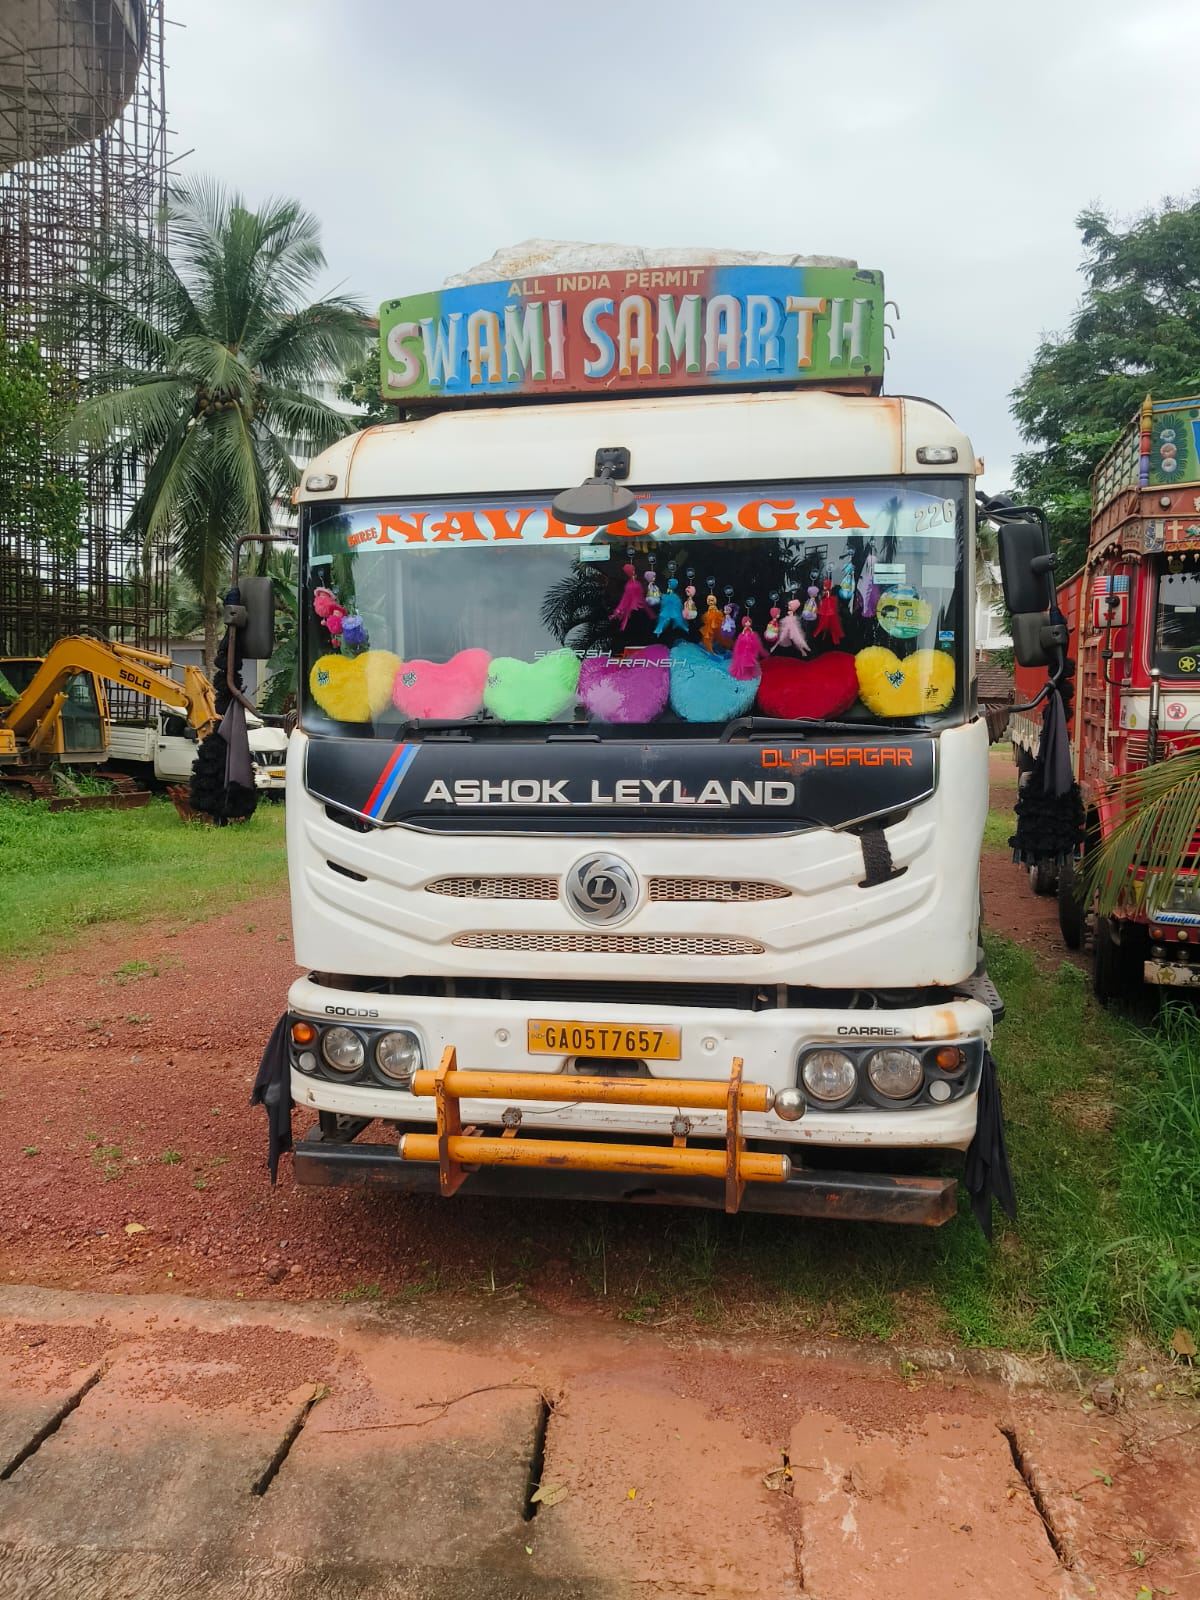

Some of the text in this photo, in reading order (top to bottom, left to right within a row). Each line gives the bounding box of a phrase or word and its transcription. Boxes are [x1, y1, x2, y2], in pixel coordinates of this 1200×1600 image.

[507, 269, 705, 297] ALL INDIA PERMIT
[387, 294, 868, 388] SWAMI SAMARTH
[914, 498, 956, 532] 226
[605, 658, 687, 669] PRANSH
[119, 669, 152, 690] SDLG
[423, 779, 796, 807] ASHOK LEYLAND
[590, 877, 615, 899] L
[325, 1005, 379, 1018] GOODS
[545, 1027, 664, 1053] GA05T7657
[837, 1026, 904, 1036] CARRIER
